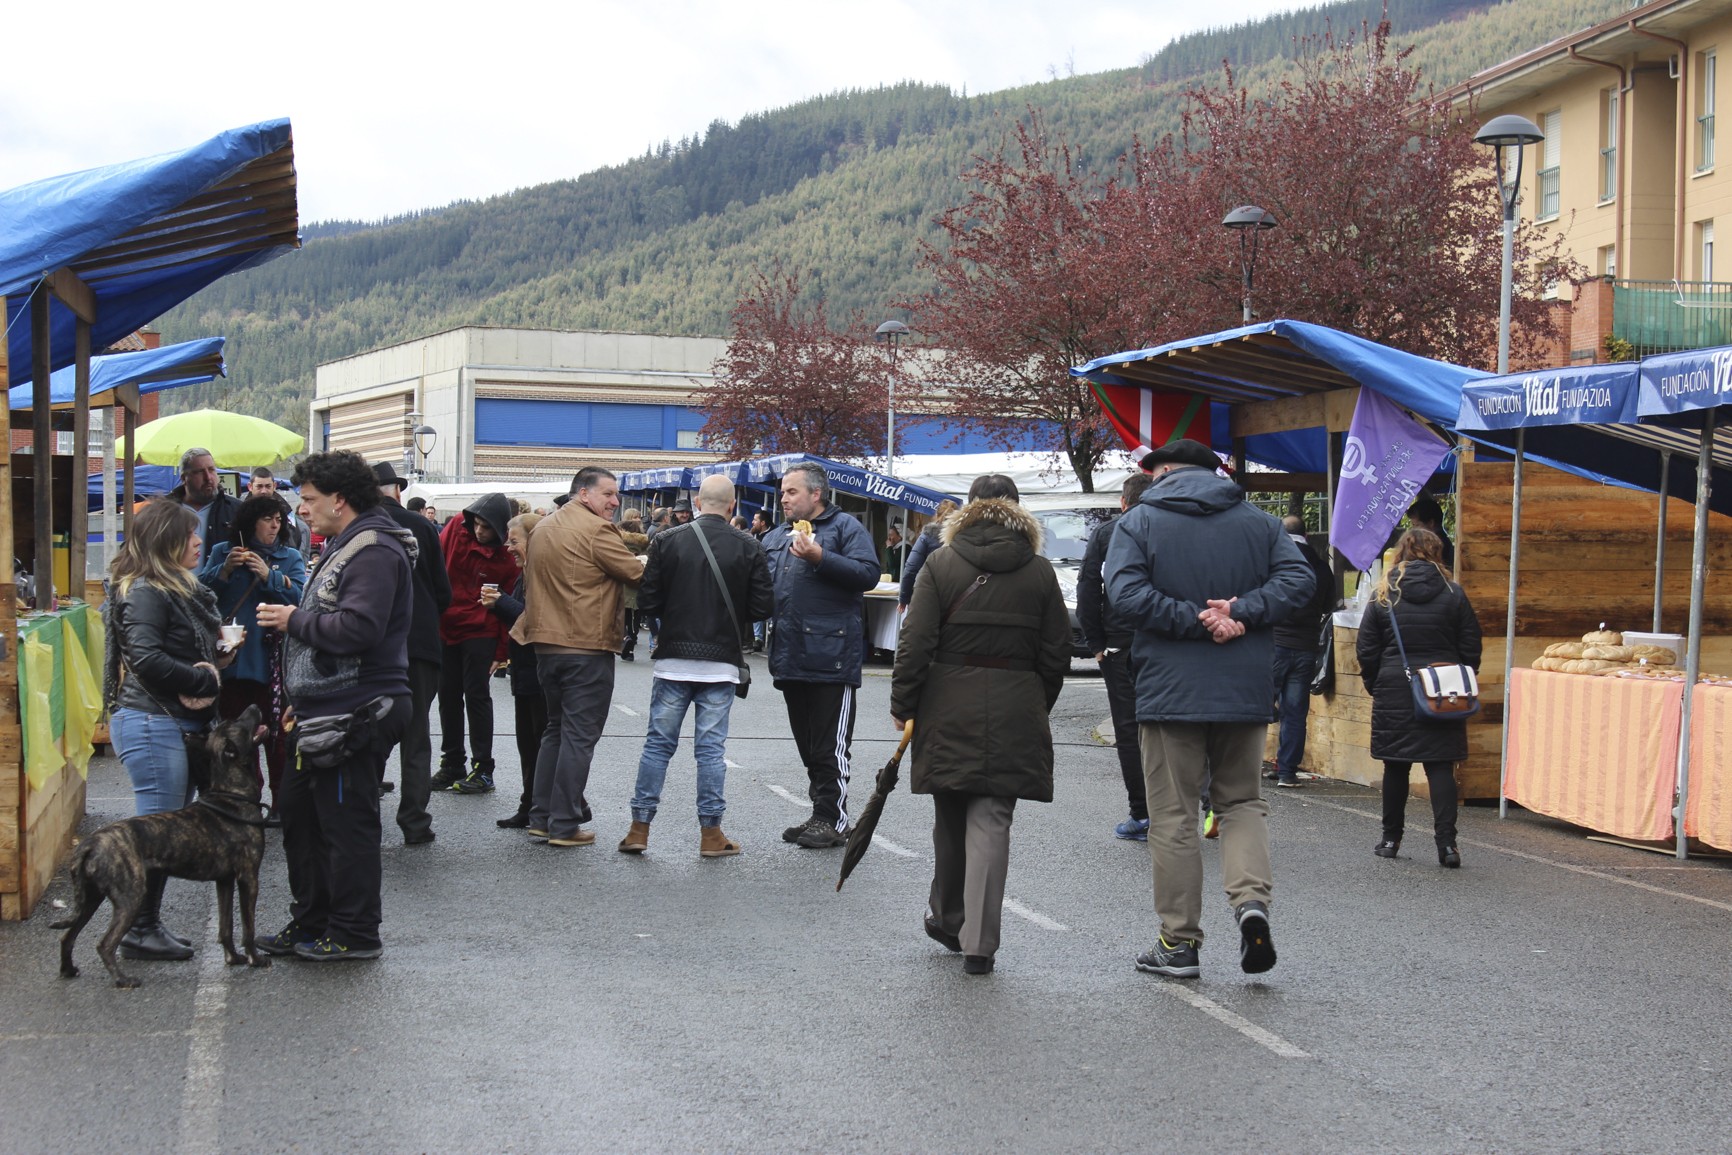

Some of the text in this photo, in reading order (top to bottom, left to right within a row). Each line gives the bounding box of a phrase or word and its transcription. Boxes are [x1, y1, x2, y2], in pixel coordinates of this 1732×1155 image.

[1478, 376, 1611, 417] FUNDACIÓN Vital FUNDAZIOA
[1661, 367, 1710, 398] FUNDACIÓN
[827, 470, 940, 511] DACIÓN Vital FUNDAZ
